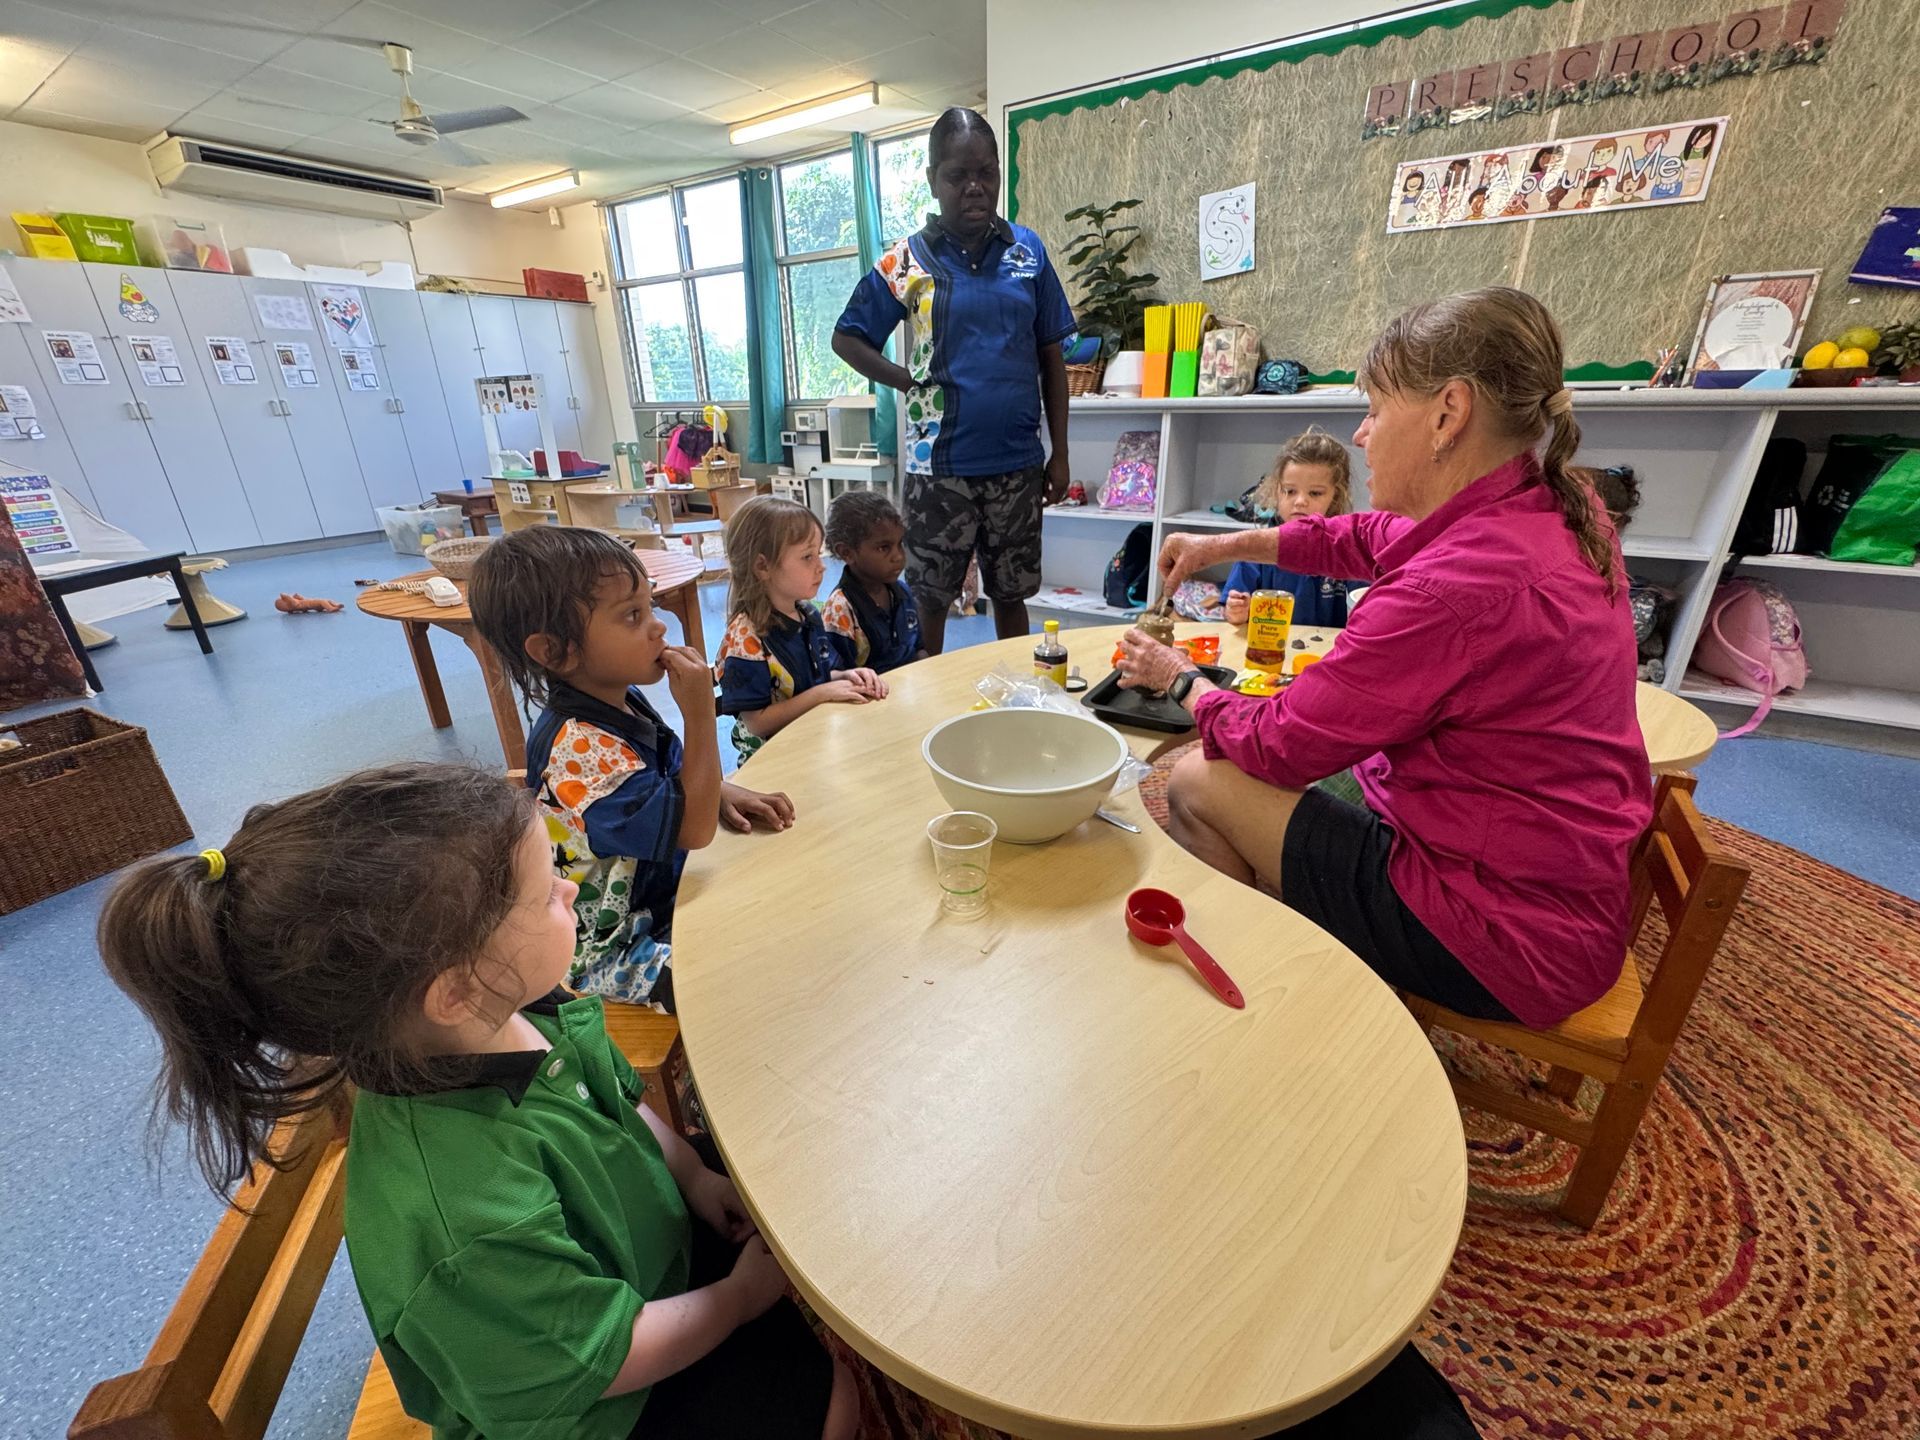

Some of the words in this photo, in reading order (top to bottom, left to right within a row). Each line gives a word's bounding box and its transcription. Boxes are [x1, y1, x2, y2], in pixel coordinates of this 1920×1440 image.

[1375, 4, 1816, 117] PRESCHOOL
[1414, 166, 1468, 207] All
[1485, 151, 1601, 198] About
[1616, 142, 1684, 183] Me
